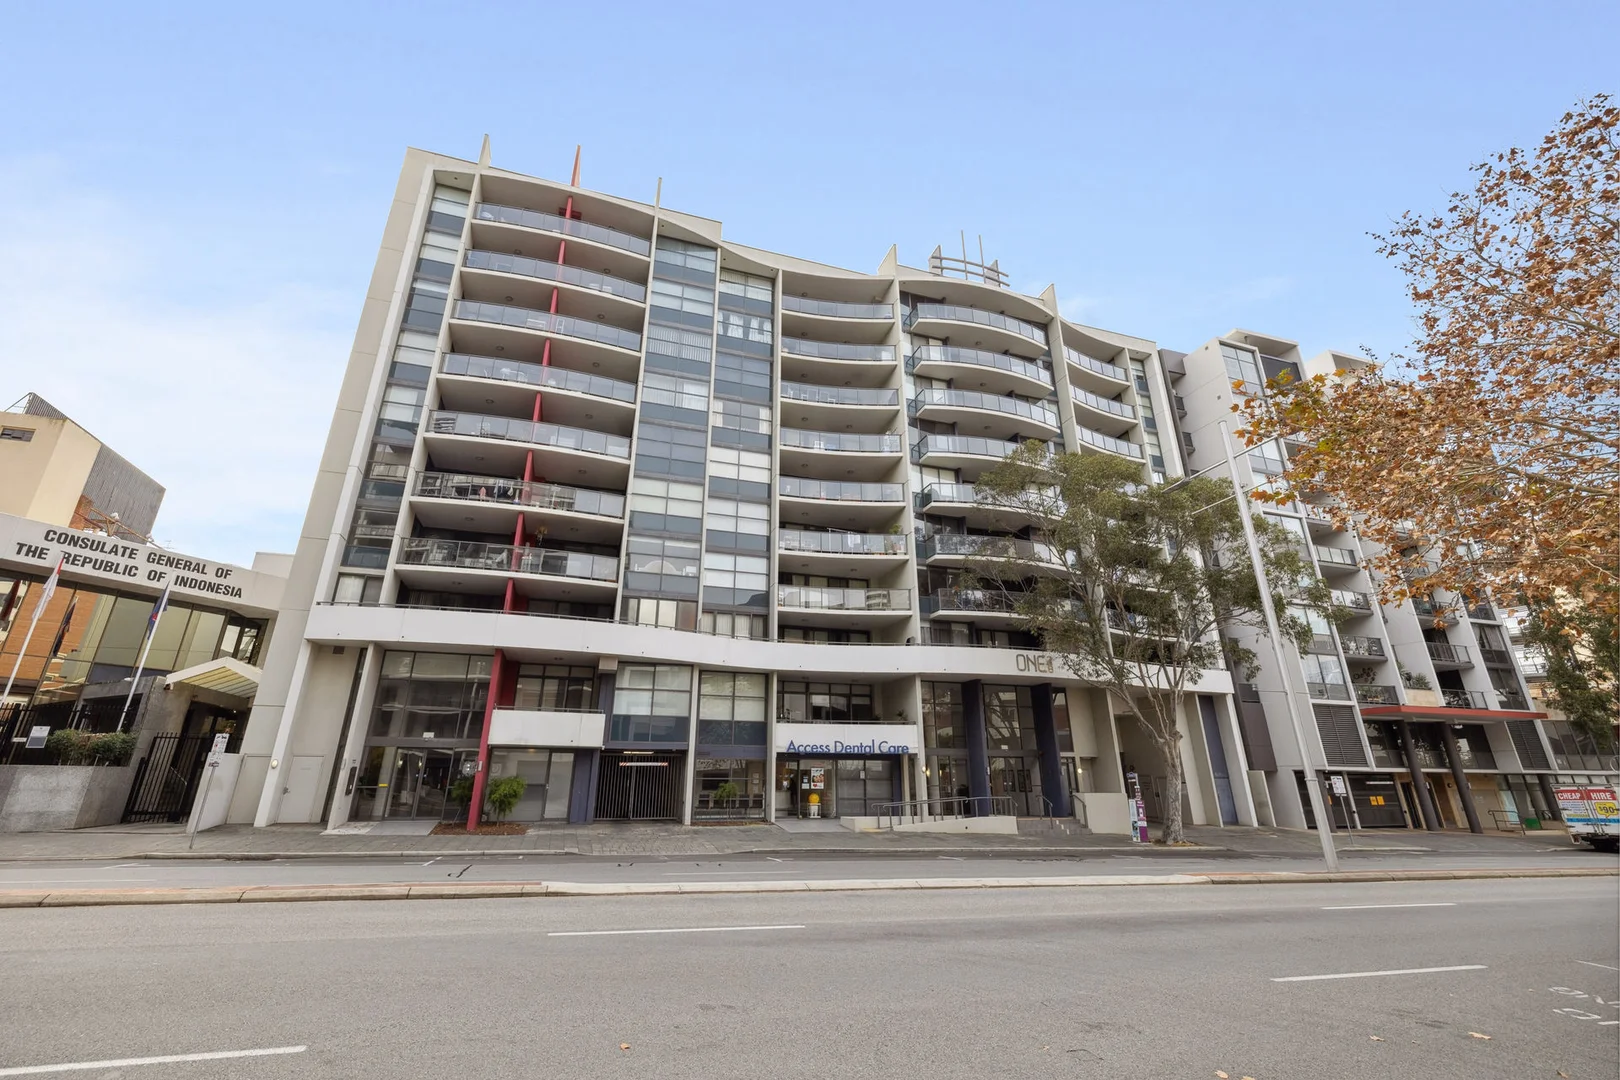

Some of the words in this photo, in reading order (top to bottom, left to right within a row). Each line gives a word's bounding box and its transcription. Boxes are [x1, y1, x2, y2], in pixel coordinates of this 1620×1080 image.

[44, 529, 139, 560] CONSULATE
[146, 551, 208, 576] GENERAL
[215, 567, 233, 580] OF
[15, 542, 50, 560] THE
[61, 551, 139, 578] REPUBLIC
[147, 569, 167, 583] OF
[174, 575, 243, 599] INDONESIA
[1016, 654, 1047, 672] ONE
[786, 740, 831, 754] Access
[834, 739, 875, 754] Dental
[878, 741, 910, 754] Care
[1598, 806, 1615, 814] $90
